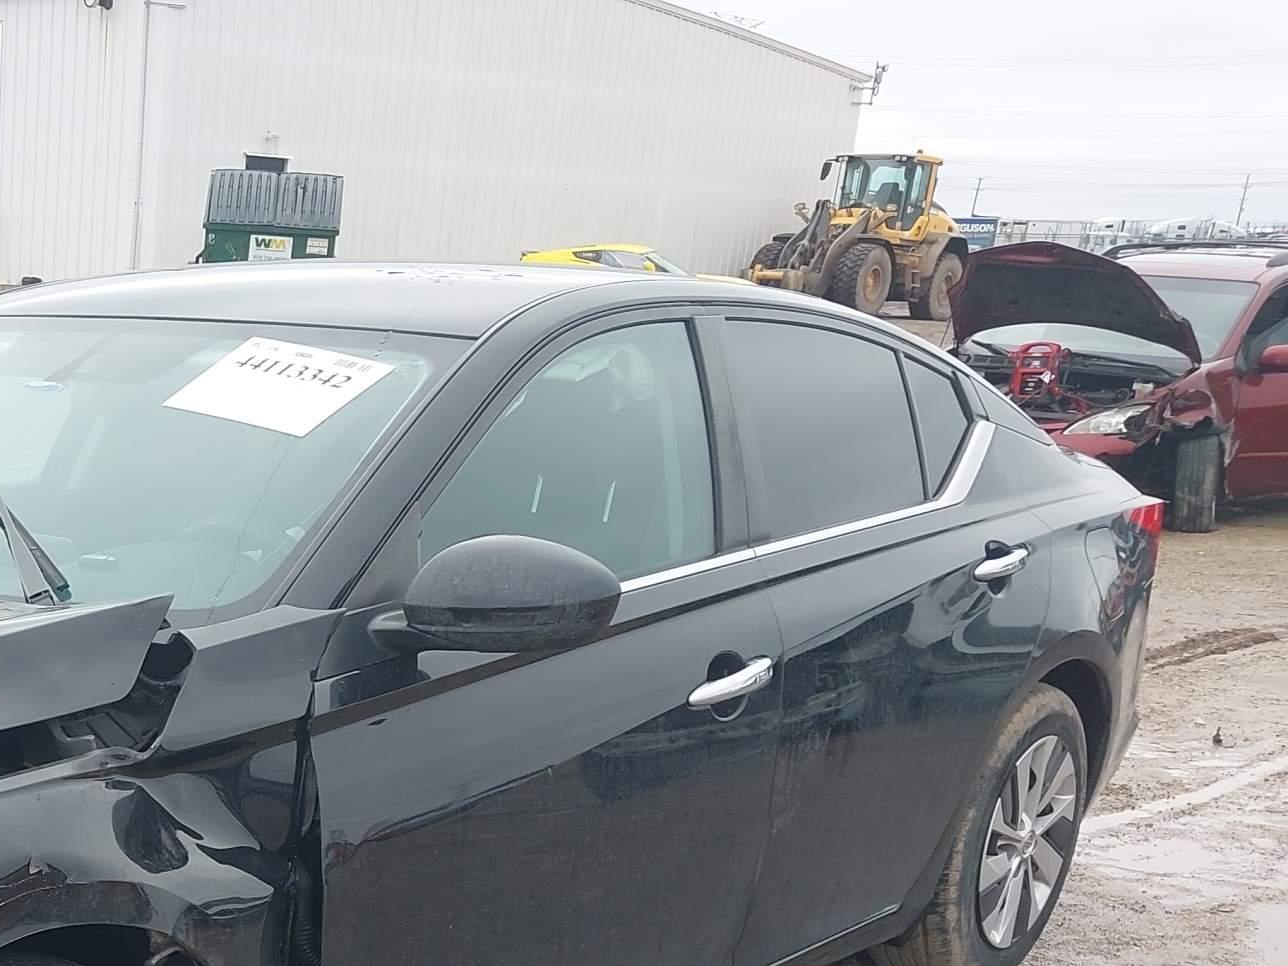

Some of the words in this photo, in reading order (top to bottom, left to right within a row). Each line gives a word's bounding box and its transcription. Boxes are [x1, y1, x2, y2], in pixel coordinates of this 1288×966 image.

[957, 223, 993, 233] GUSON
[255, 237, 287, 249] WM
[236, 355, 352, 389] 44113342
